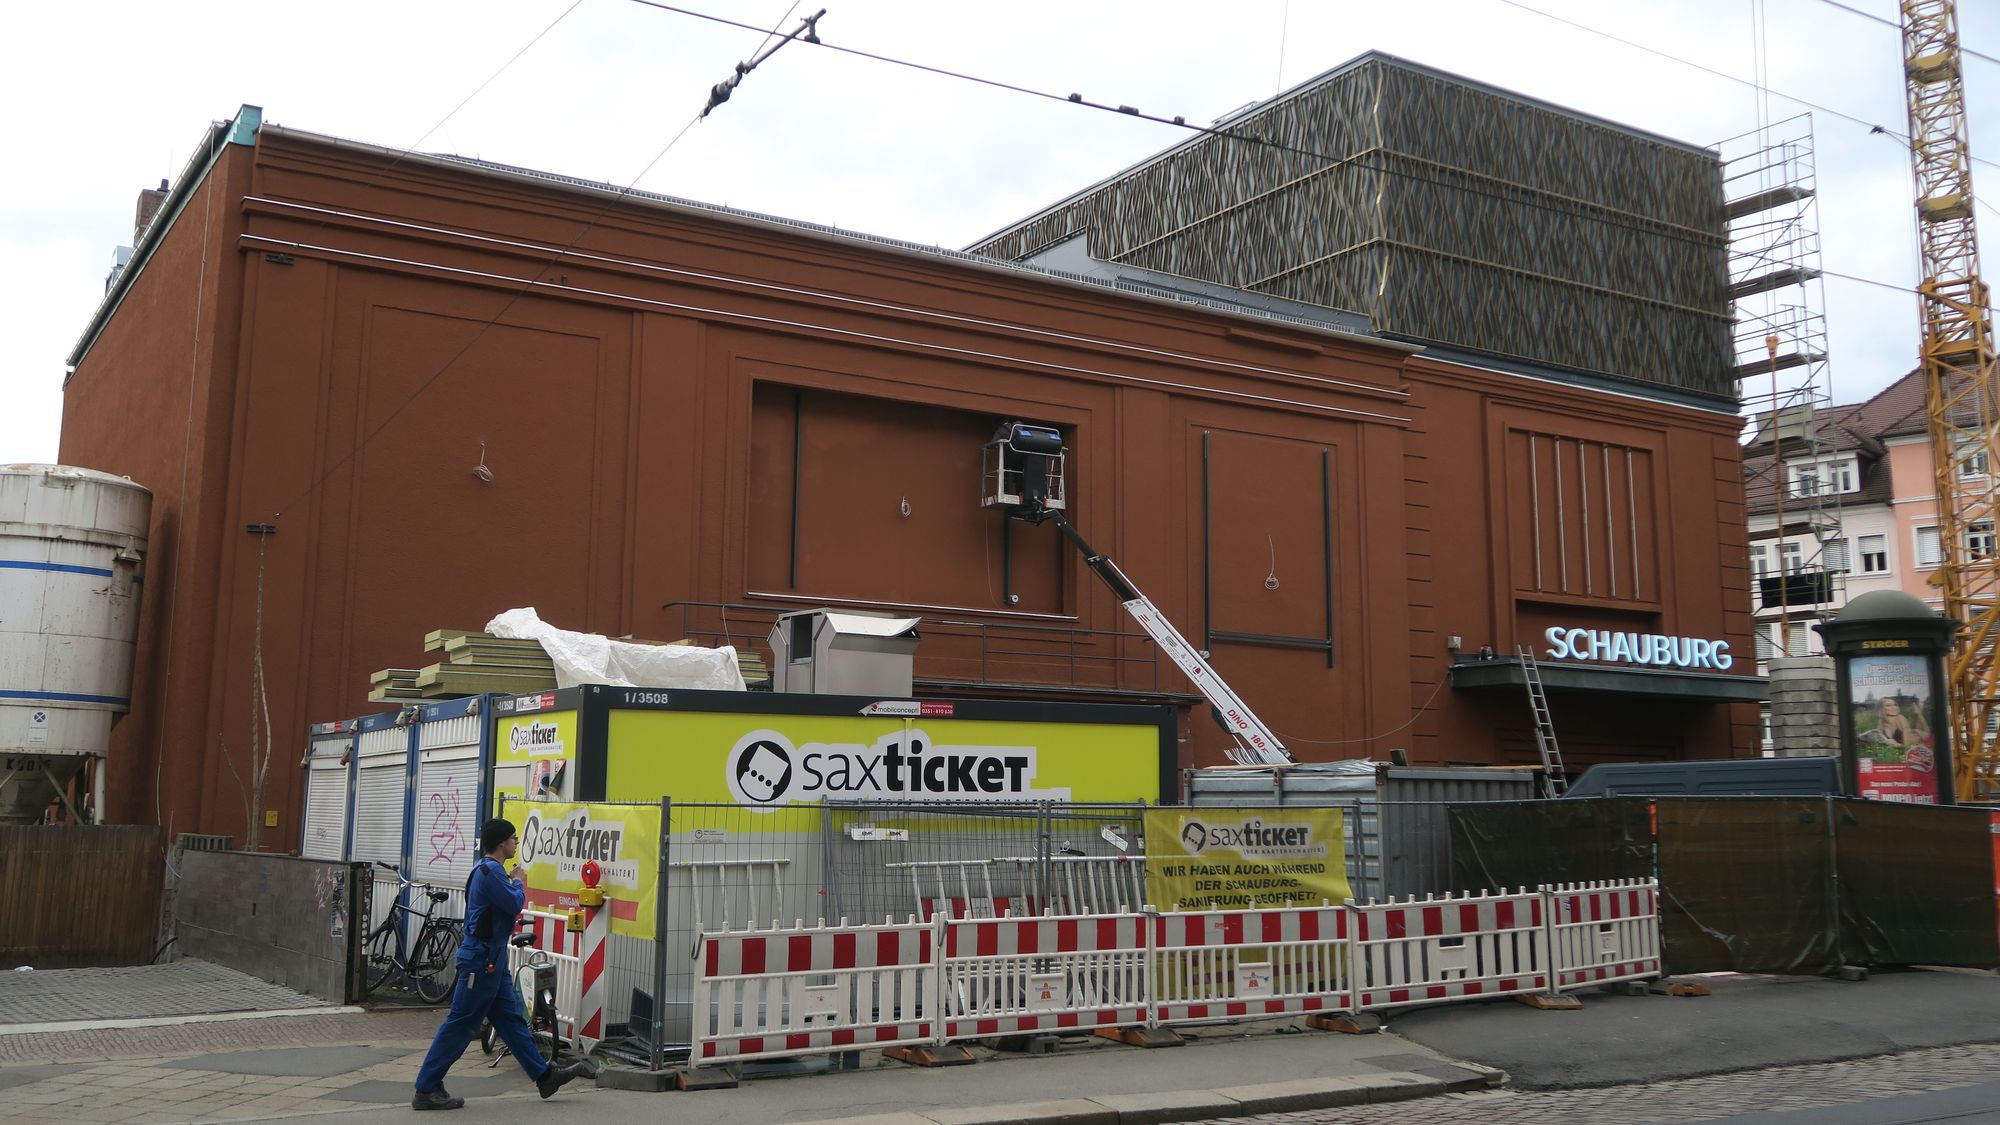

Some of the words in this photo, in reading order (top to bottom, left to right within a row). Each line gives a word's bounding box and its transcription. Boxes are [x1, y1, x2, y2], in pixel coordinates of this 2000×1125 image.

[1545, 626, 1733, 670] SCHAUBURG
[624, 692, 668, 704] 1/3508
[1227, 709, 1248, 730] DINO
[1163, 866, 1186, 877] WIR
[1190, 865, 1230, 876] HABEN
[1234, 865, 1270, 876] AUCH
[1271, 863, 1326, 875] WÄHREND
[1195, 880, 1222, 891] DER
[1178, 894, 1251, 909] SANIERUNG
